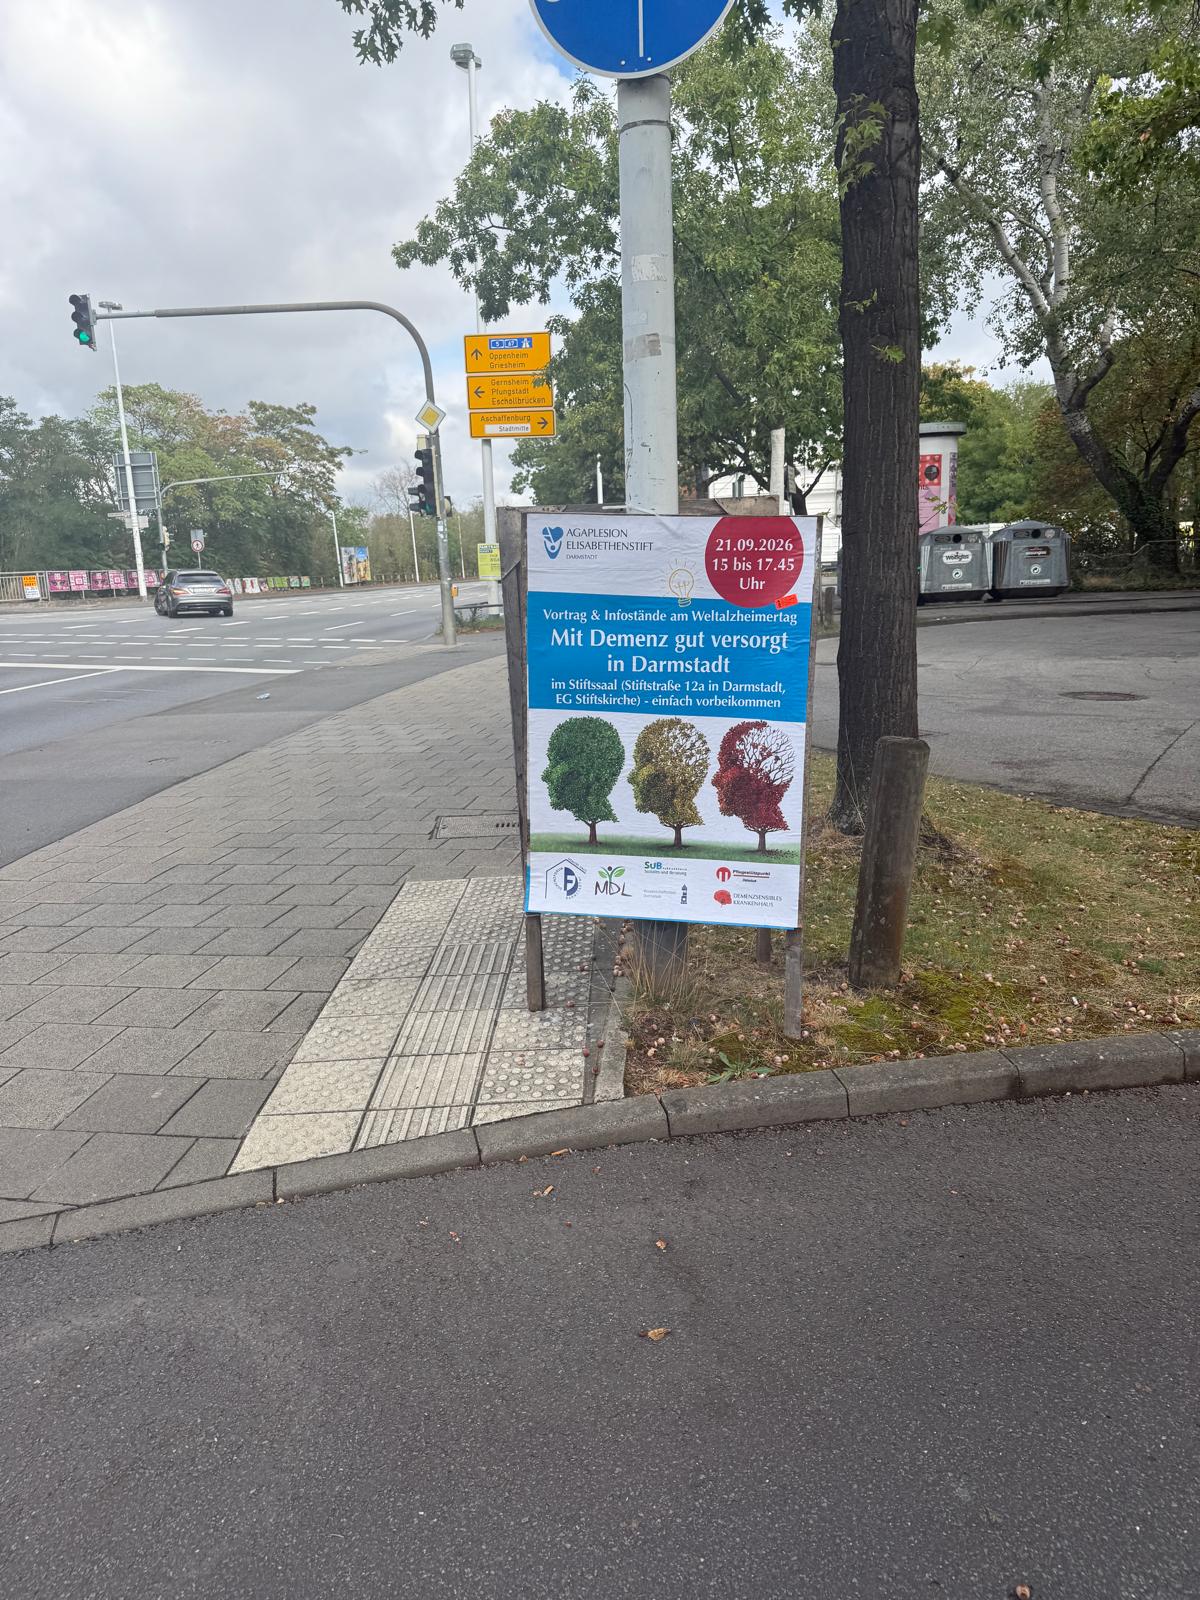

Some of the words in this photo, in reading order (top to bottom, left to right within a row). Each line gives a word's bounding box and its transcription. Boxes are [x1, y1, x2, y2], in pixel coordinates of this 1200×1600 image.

[566, 527, 628, 538] AGAPLESION
[566, 540, 654, 551] ELISABETHENSTIFT
[715, 538, 794, 552] 21.09.2026
[712, 558, 728, 571] 15
[733, 558, 752, 571] bis
[757, 558, 794, 571] 17.45
[739, 577, 766, 590] Uhr
[543, 609, 587, 623] Vortrag
[591, 610, 600, 621] &
[604, 610, 666, 622] Infostände
[670, 613, 688, 622] am
[692, 611, 797, 625] Weltalzheimertag
[551, 629, 583, 646] Mit
[590, 630, 668, 648] Demenz
[675, 632, 704, 653] gut
[711, 632, 788, 654] versorgt
[607, 654, 624, 672] in
[632, 656, 730, 673] Darmstadt
[551, 680, 566, 689] im
[569, 679, 617, 691] Stiftssaal
[621, 680, 681, 693] (Stiftstraße
[685, 681, 705, 691] 12a
[708, 682, 719, 692] in
[722, 682, 786, 694] Darmstadt,
[556, 694, 572, 705] EG
[575, 694, 641, 707] Stiftskirche)
[652, 696, 693, 707] einfach
[696, 696, 781, 708] vorbeikommen
[594, 880, 632, 897] MDL
